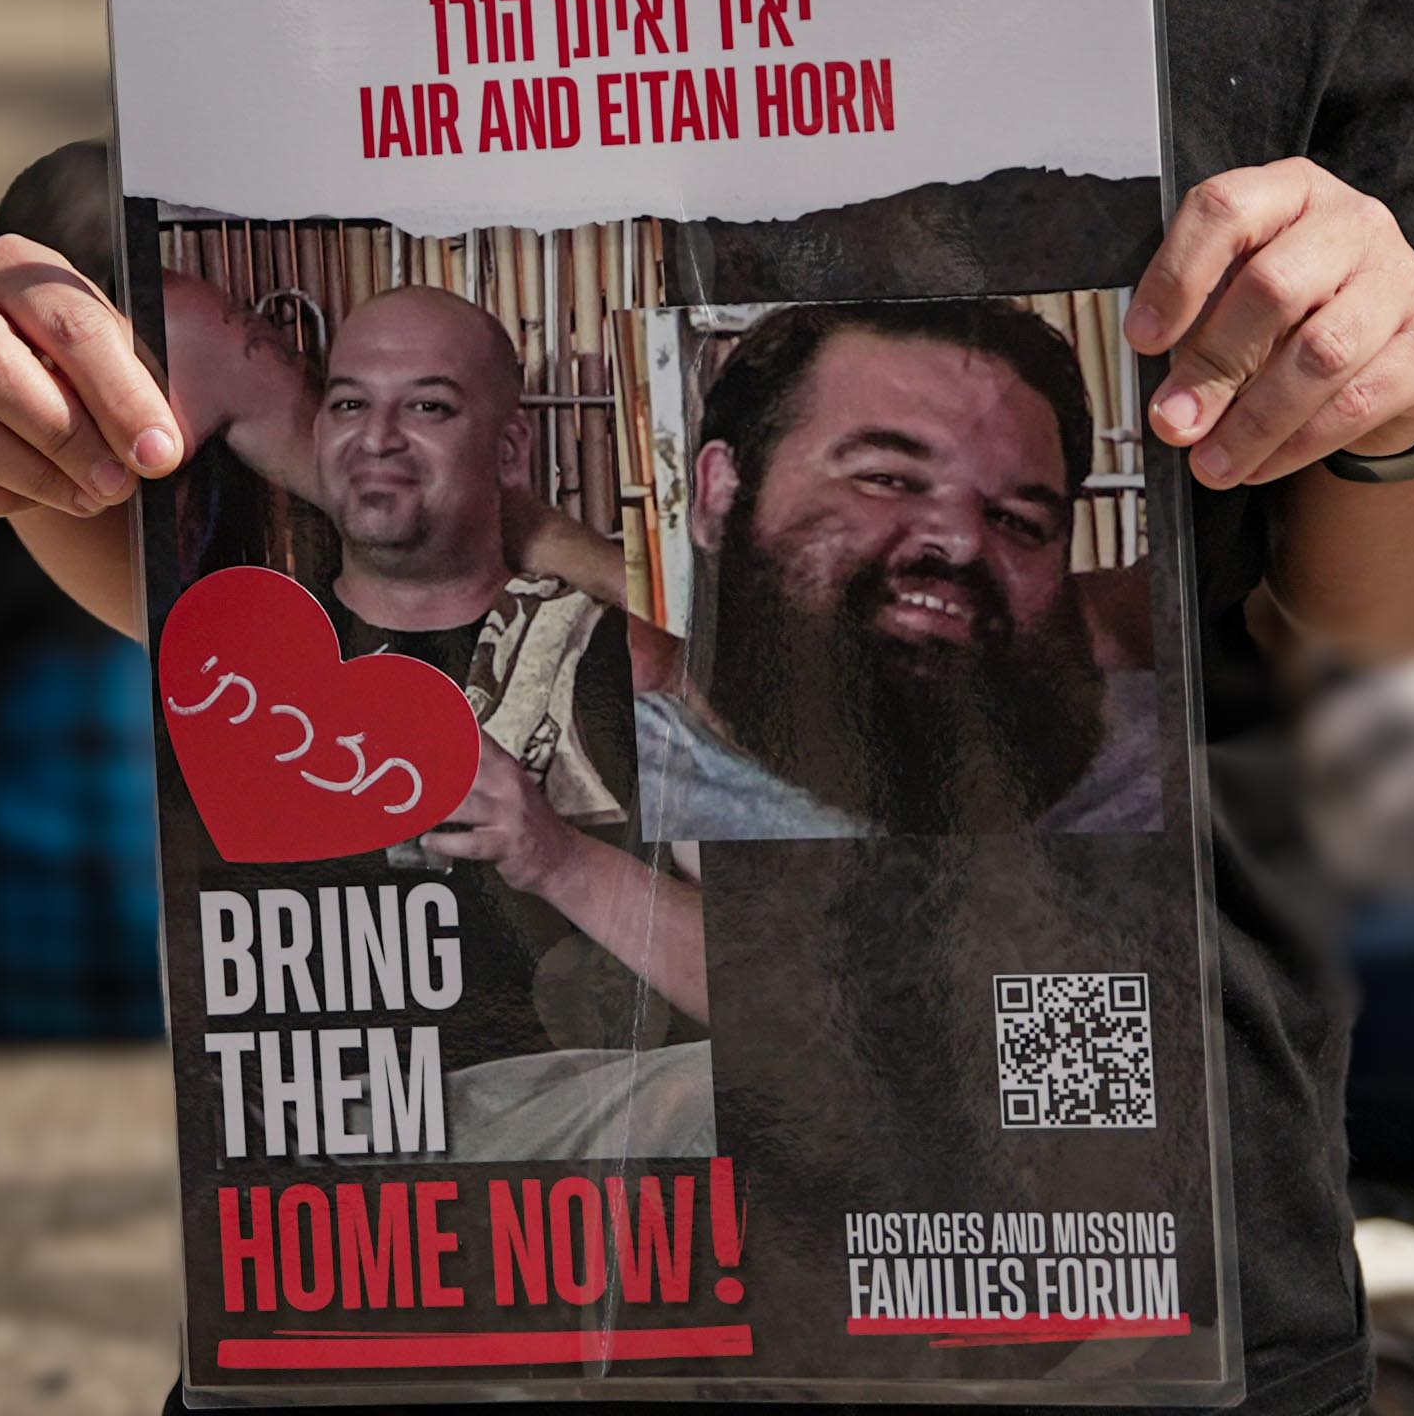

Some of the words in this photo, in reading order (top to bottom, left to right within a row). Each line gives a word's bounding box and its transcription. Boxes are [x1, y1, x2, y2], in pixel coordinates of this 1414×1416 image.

[360, 82, 464, 159] IAIR
[479, 75, 582, 153] AND
[597, 66, 740, 147] EITAN
[755, 58, 896, 138] HORN
[167, 654, 424, 815] חזרתי
[199, 882, 464, 1016] BRING
[204, 1026, 446, 1158] THEM
[218, 1179, 466, 1313] HOME
[489, 1156, 750, 1307] NOW!
[845, 1211, 985, 1255] HOSTAGES
[991, 1211, 1046, 1255] AND
[1052, 1211, 1176, 1255] MISSING
[848, 1257, 1027, 1321] FAMILIES
[1036, 1257, 1180, 1321] FORUM
